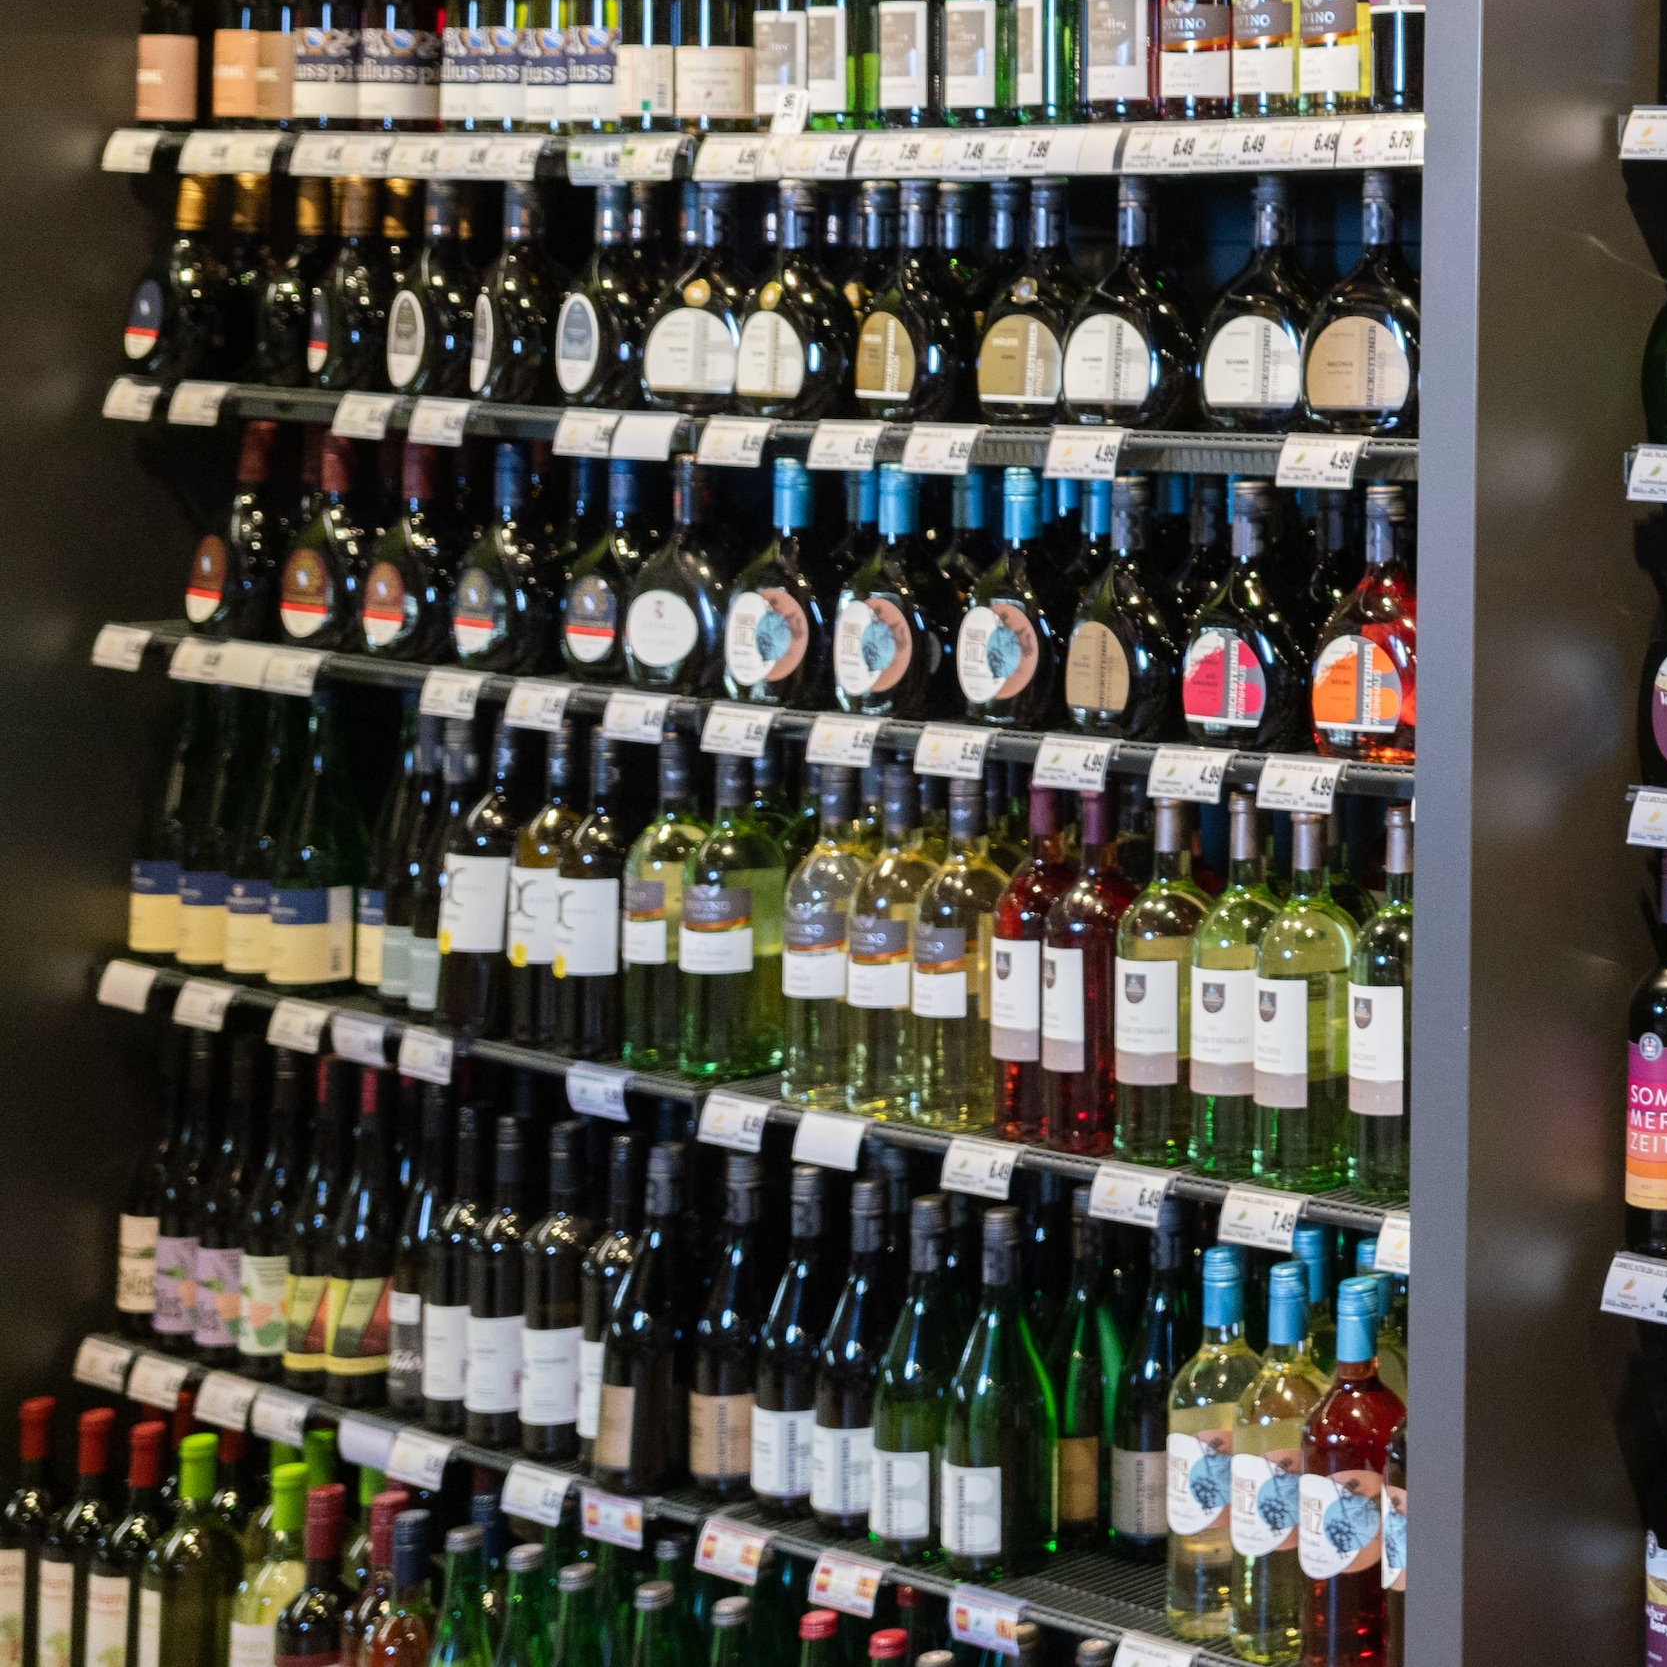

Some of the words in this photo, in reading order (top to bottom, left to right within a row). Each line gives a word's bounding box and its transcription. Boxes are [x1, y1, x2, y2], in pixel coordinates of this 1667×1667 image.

[1173, 139, 1195, 158] 6.49
[1314, 133, 1338, 152] 6.49
[1389, 131, 1413, 149] 5.79
[1330, 453, 1354, 473] 4.99
